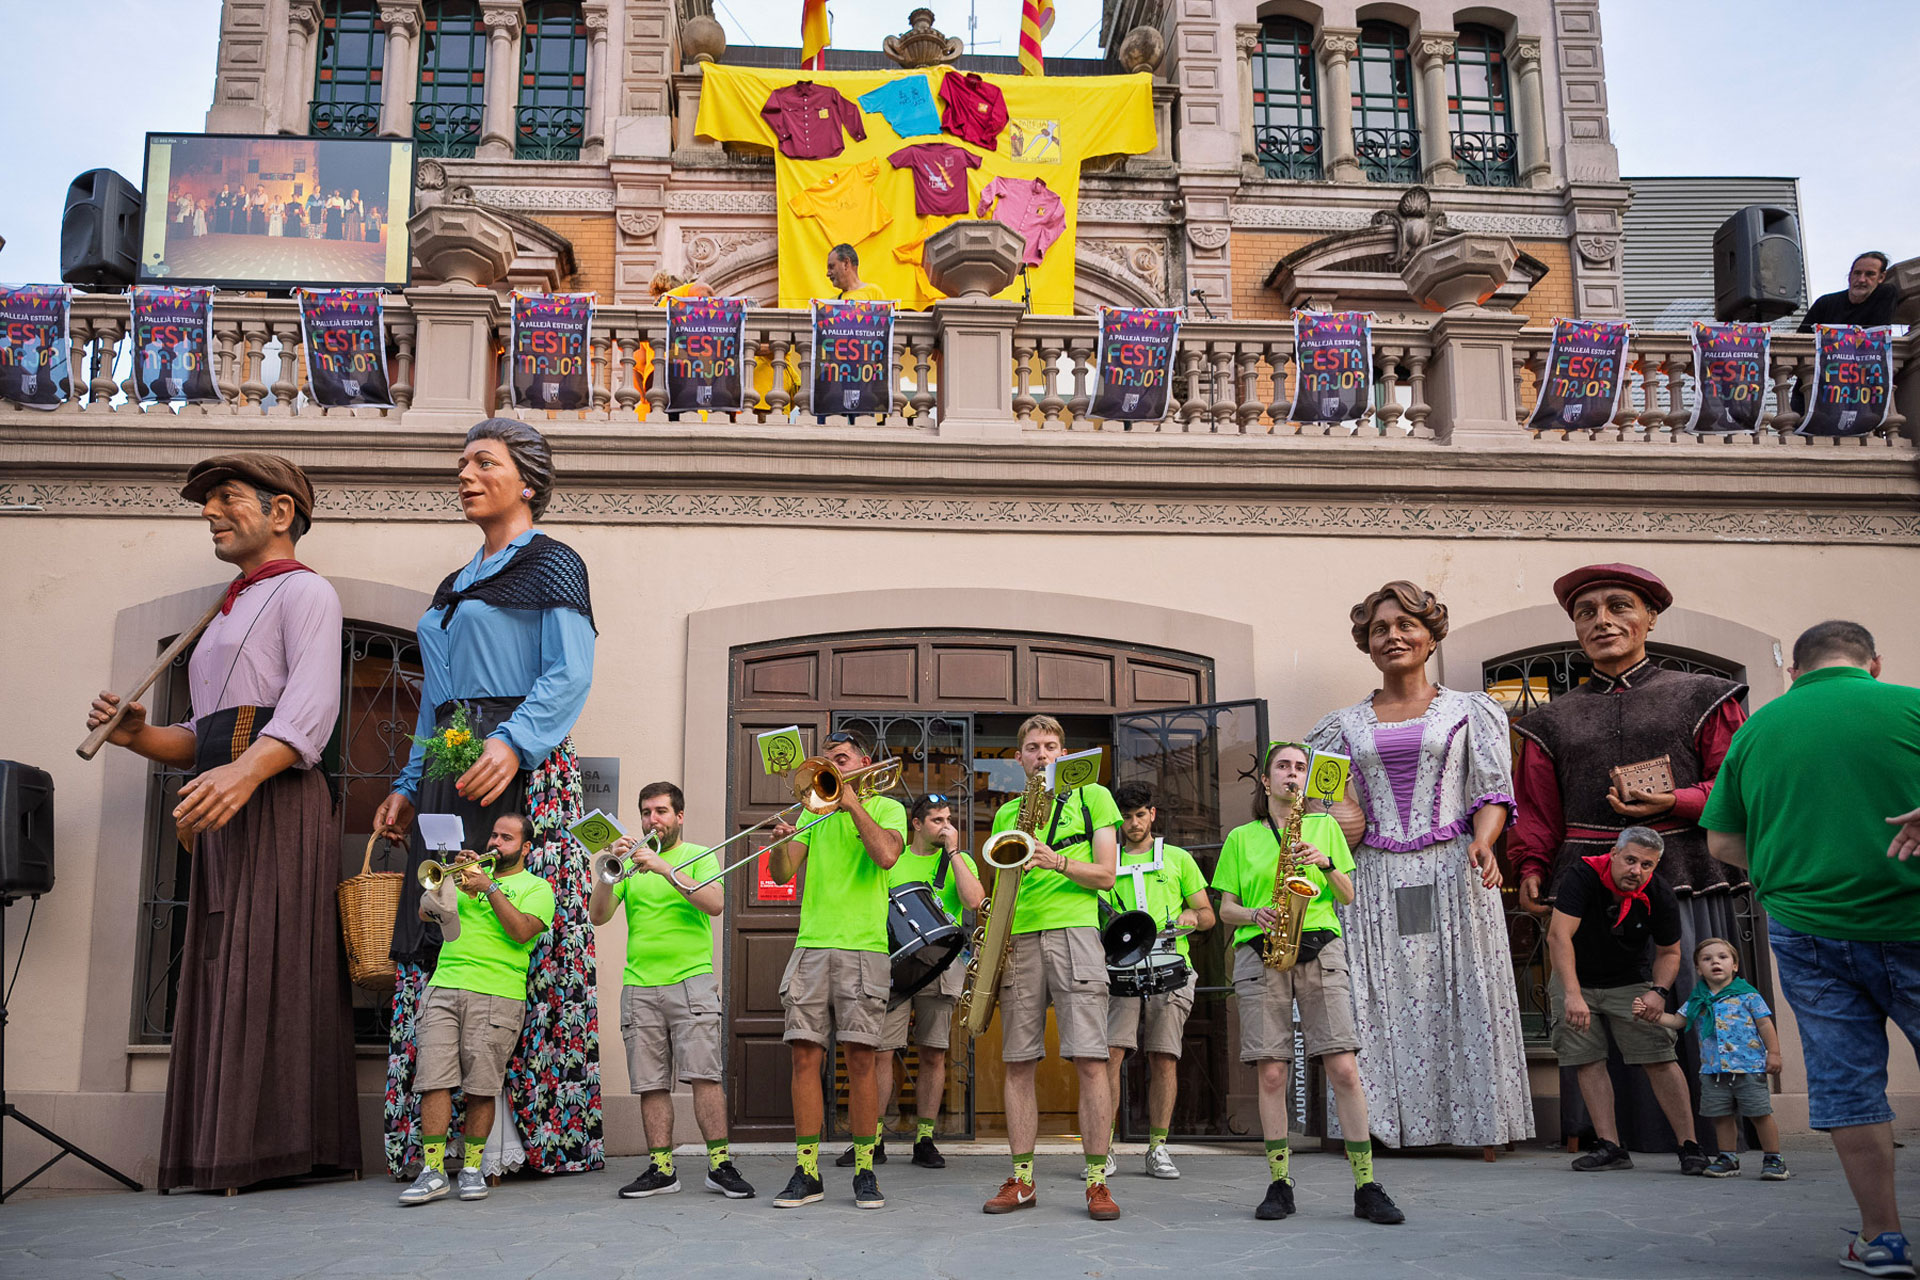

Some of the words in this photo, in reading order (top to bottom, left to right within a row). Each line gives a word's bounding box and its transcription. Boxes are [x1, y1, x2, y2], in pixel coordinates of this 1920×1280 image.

[138, 325, 203, 350] FESTA
[312, 329, 374, 351] FESTA
[519, 331, 582, 354] FESTA
[674, 336, 735, 358] FESTA
[1307, 339, 1333, 347] PALLEJÀ
[821, 339, 884, 361] FESTA
[1107, 344, 1167, 367] FESTA
[1301, 348, 1363, 370] FESTA
[314, 351, 378, 372] MAJOR
[517, 355, 582, 376] MAJOR
[673, 358, 735, 378] MAJOR
[1556, 356, 1613, 379] FESTA
[820, 363, 883, 382] MAJOR
[1105, 366, 1164, 387] MAJOR
[1825, 363, 1883, 384] FESTA
[1550, 378, 1611, 398] MAJOR
[1822, 385, 1884, 404] MAJOR
[584, 784, 611, 793] VILA
[1294, 1030, 1306, 1124] AJUNTAMENT
